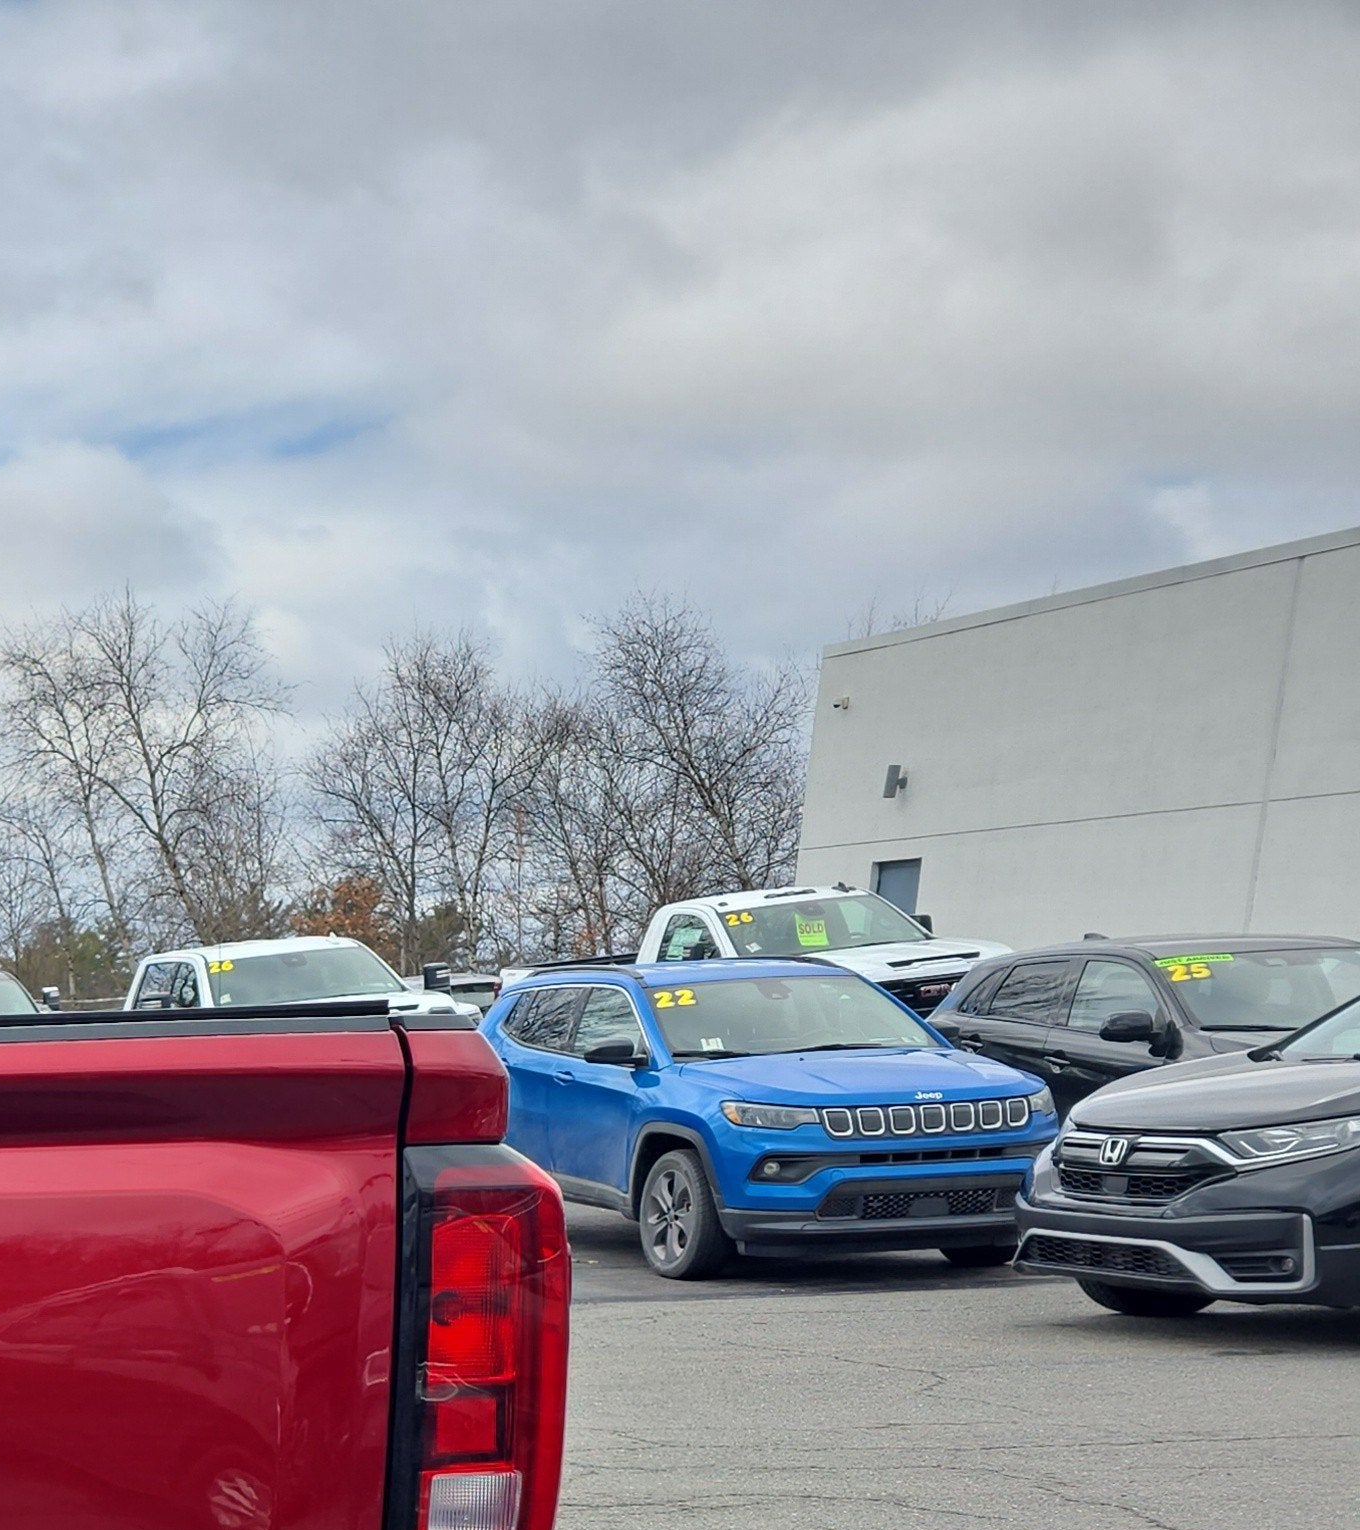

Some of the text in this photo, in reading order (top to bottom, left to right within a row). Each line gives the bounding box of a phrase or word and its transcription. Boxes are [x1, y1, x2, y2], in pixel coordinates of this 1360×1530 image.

[726, 912, 753, 926] 26
[799, 922, 824, 934] SOLD
[208, 960, 234, 973] 26
[1167, 963, 1211, 982] 25
[653, 989, 697, 1008] 22
[915, 1091, 943, 1100] Jeep
